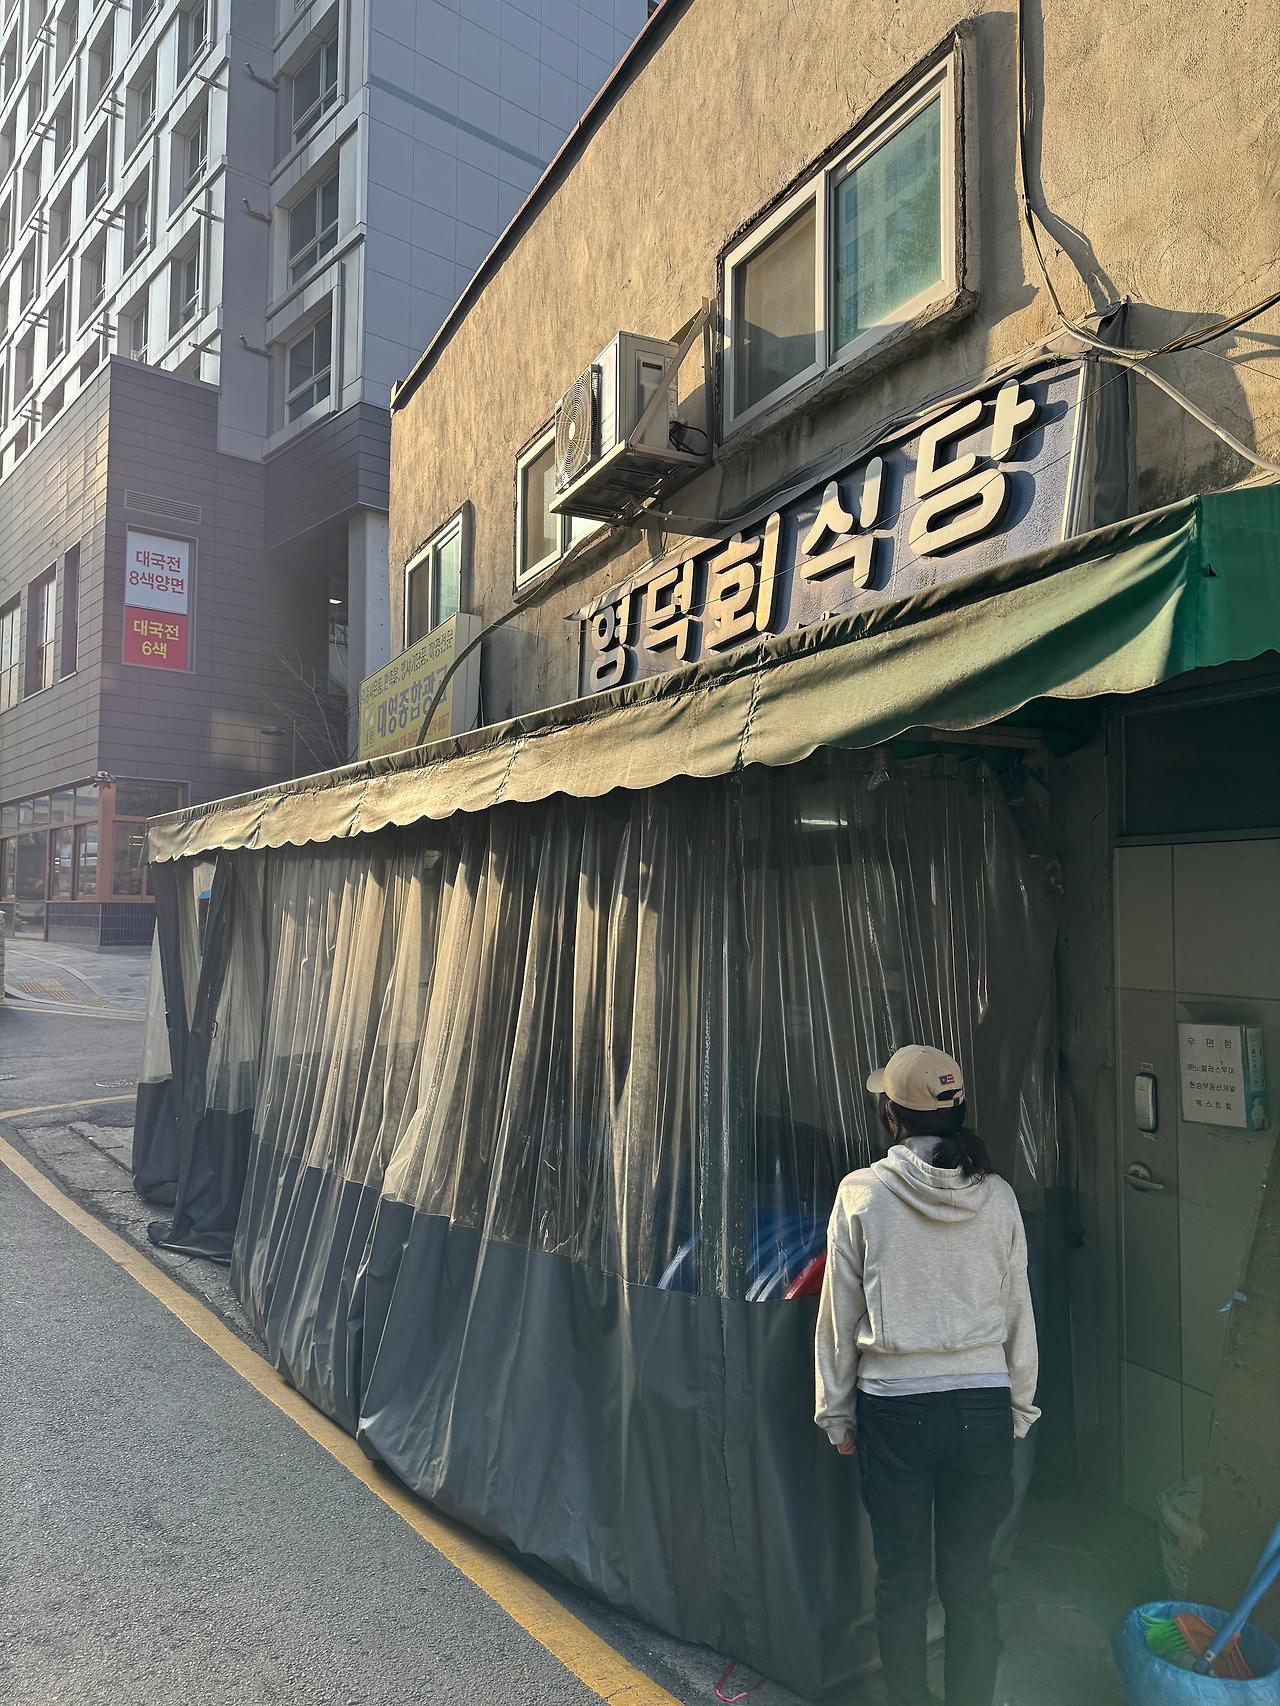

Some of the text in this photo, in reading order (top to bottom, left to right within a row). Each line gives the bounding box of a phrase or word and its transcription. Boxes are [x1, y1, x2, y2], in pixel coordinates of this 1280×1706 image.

[589, 378, 1038, 693] 영덕회식당
[136, 550, 181, 573] 대국전
[129, 570, 184, 594] 8색양면
[133, 619, 179, 640] 대국전
[141, 641, 167, 659] 6색
[377, 664, 447, 738] 대영종합광고
